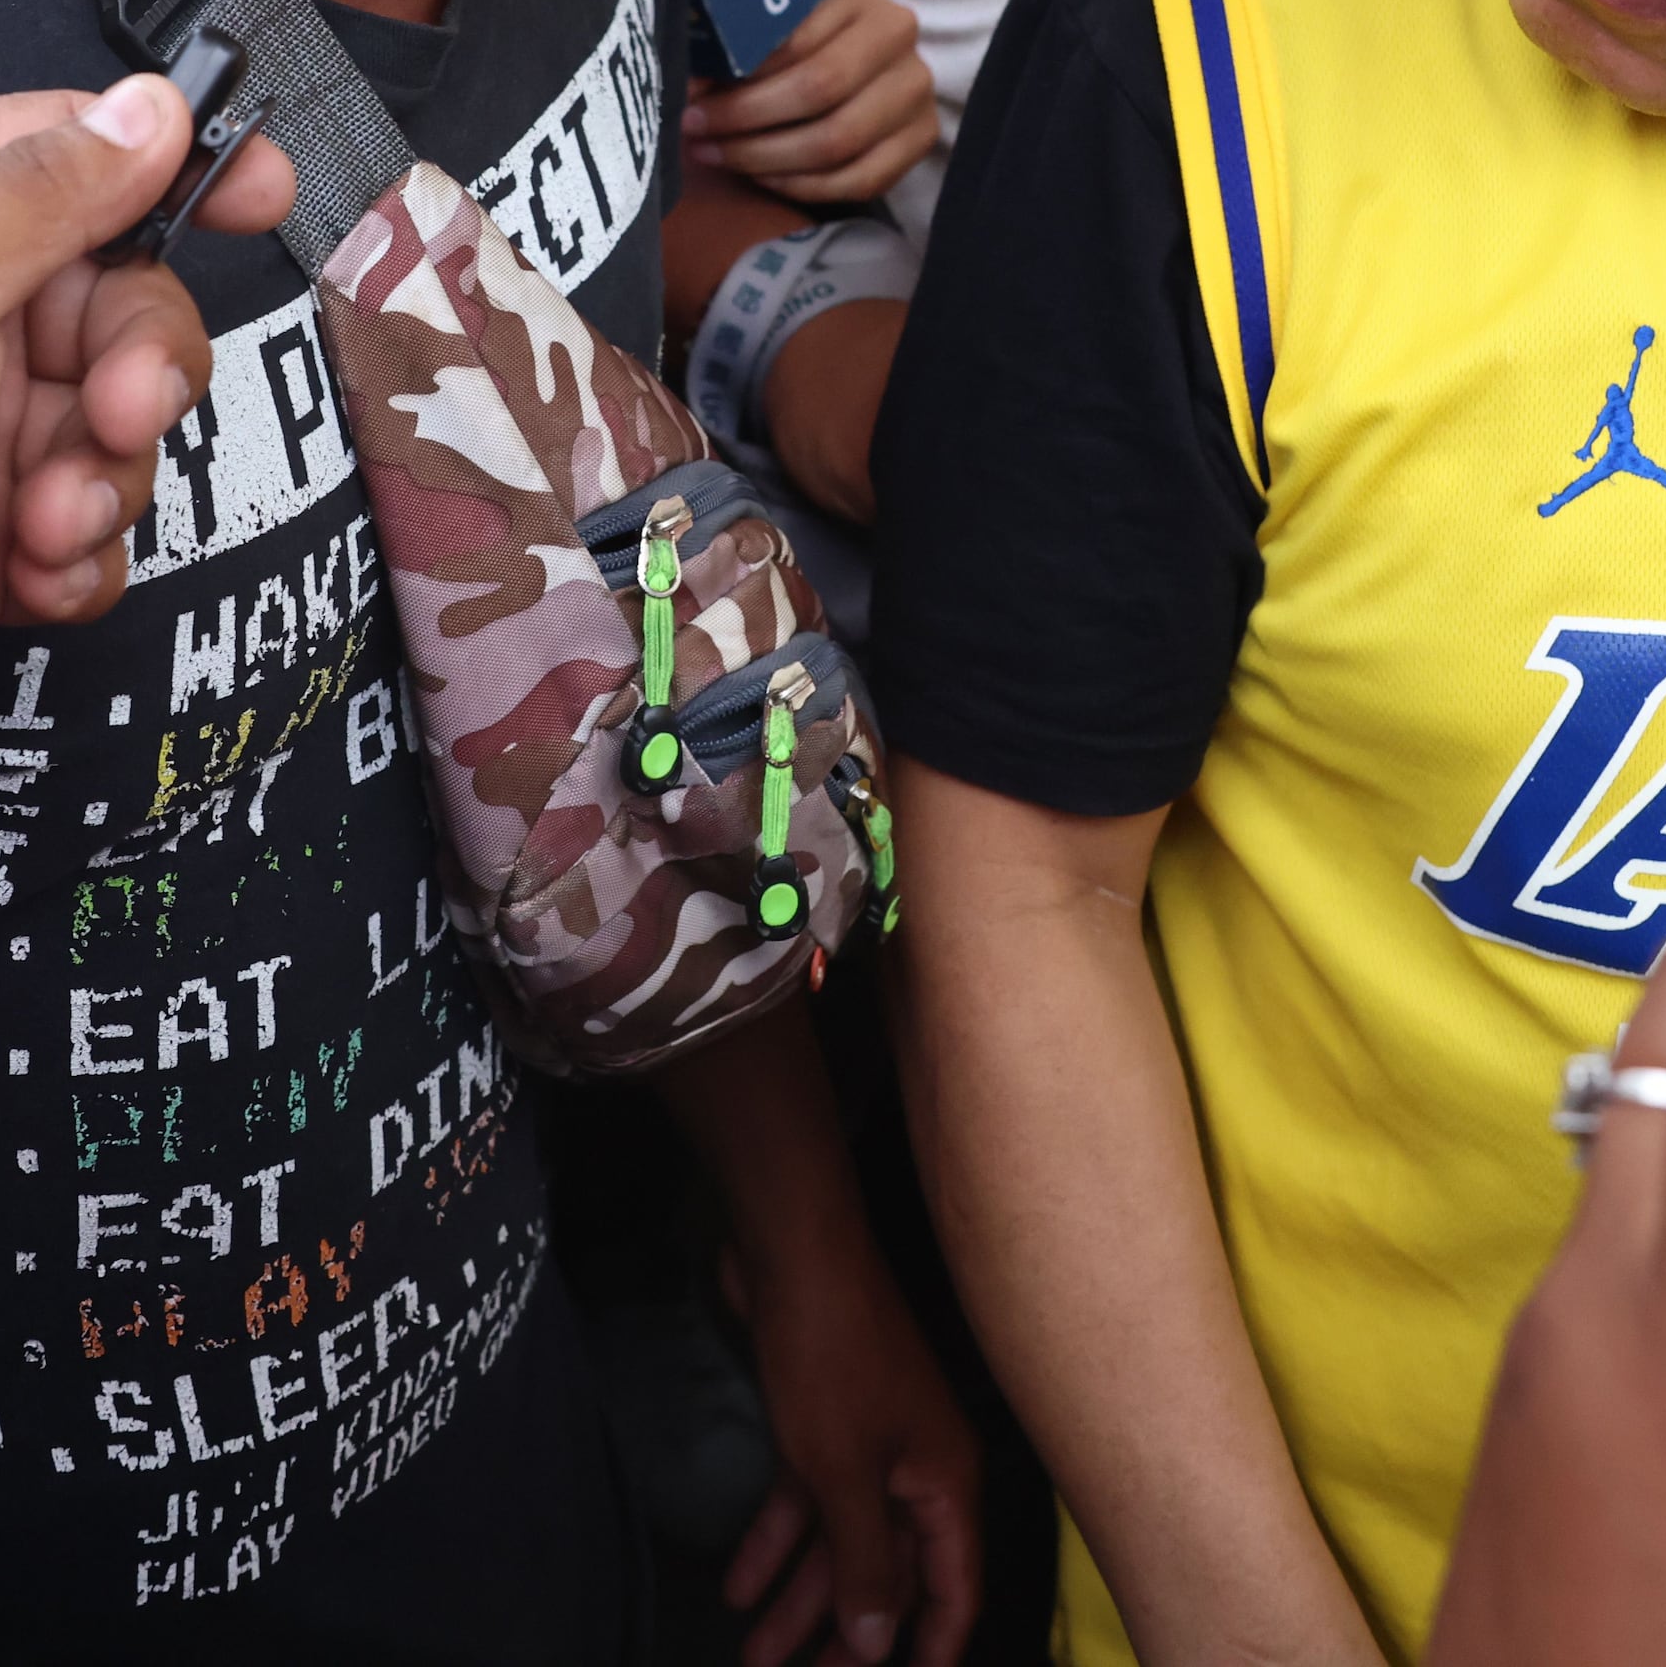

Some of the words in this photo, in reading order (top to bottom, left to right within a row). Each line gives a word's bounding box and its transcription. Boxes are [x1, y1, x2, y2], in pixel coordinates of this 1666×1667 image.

[170, 512, 383, 717] WAKE
[69, 954, 293, 1077] EAT
[76, 1158, 296, 1278] EAT
[136, 1513, 296, 1608] PLAY
